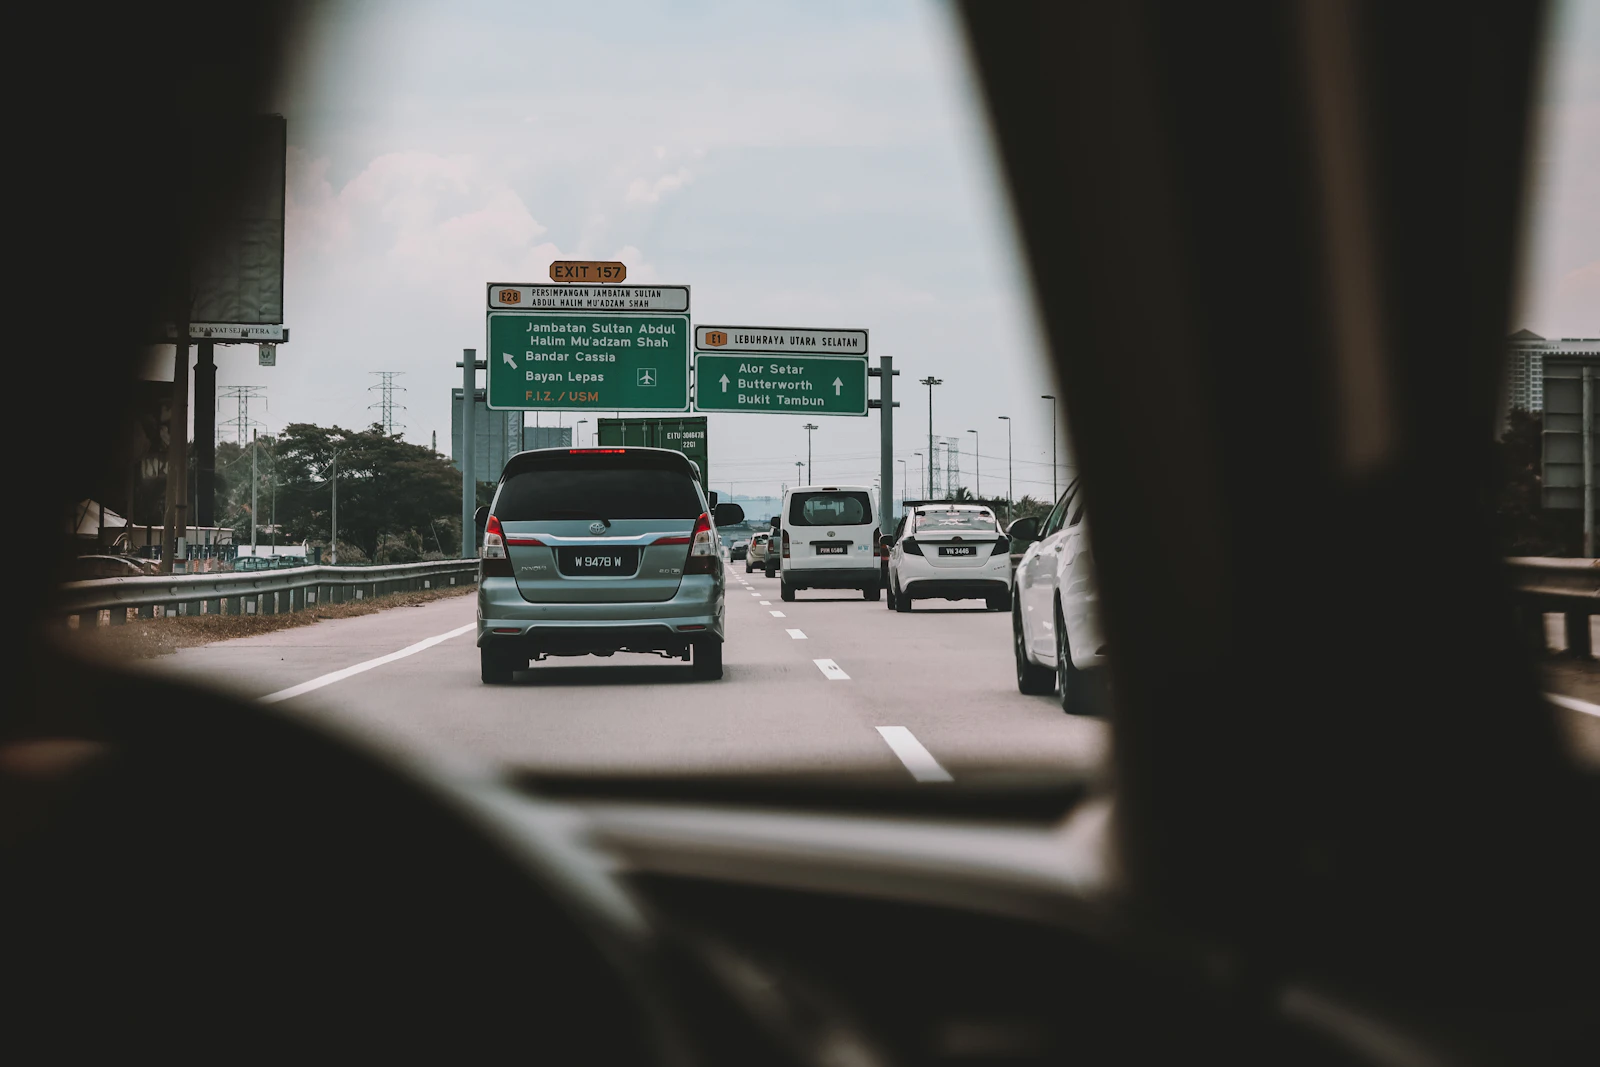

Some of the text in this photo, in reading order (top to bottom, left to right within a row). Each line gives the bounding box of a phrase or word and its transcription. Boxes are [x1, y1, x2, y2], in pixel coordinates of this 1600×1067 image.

[555, 266, 621, 278] EXIT 157
[502, 292, 518, 302] E28
[532, 289, 662, 298] PERSIMPANGAN JAMBATAN SULTAN
[532, 298, 649, 308] ABDUL HALIM MU'ADZAM SHAH
[526, 322, 676, 334] Jambatan Sultan Abdul
[530, 336, 669, 348] Halim Mu'adzam Shah
[712, 334, 721, 344] E1
[734, 334, 858, 347] LEBUHRAYA UTARA SELATAN
[525, 351, 616, 362] Bandar Cassia
[738, 363, 804, 374] Alor Setar
[525, 371, 604, 384] Bayan Lepas
[738, 379, 813, 390] Butterworth
[525, 391, 554, 401] F.I.Z.
[568, 392, 599, 402] USM
[738, 394, 825, 406] Bukit Tambun
[574, 556, 622, 567] W 9478 W
